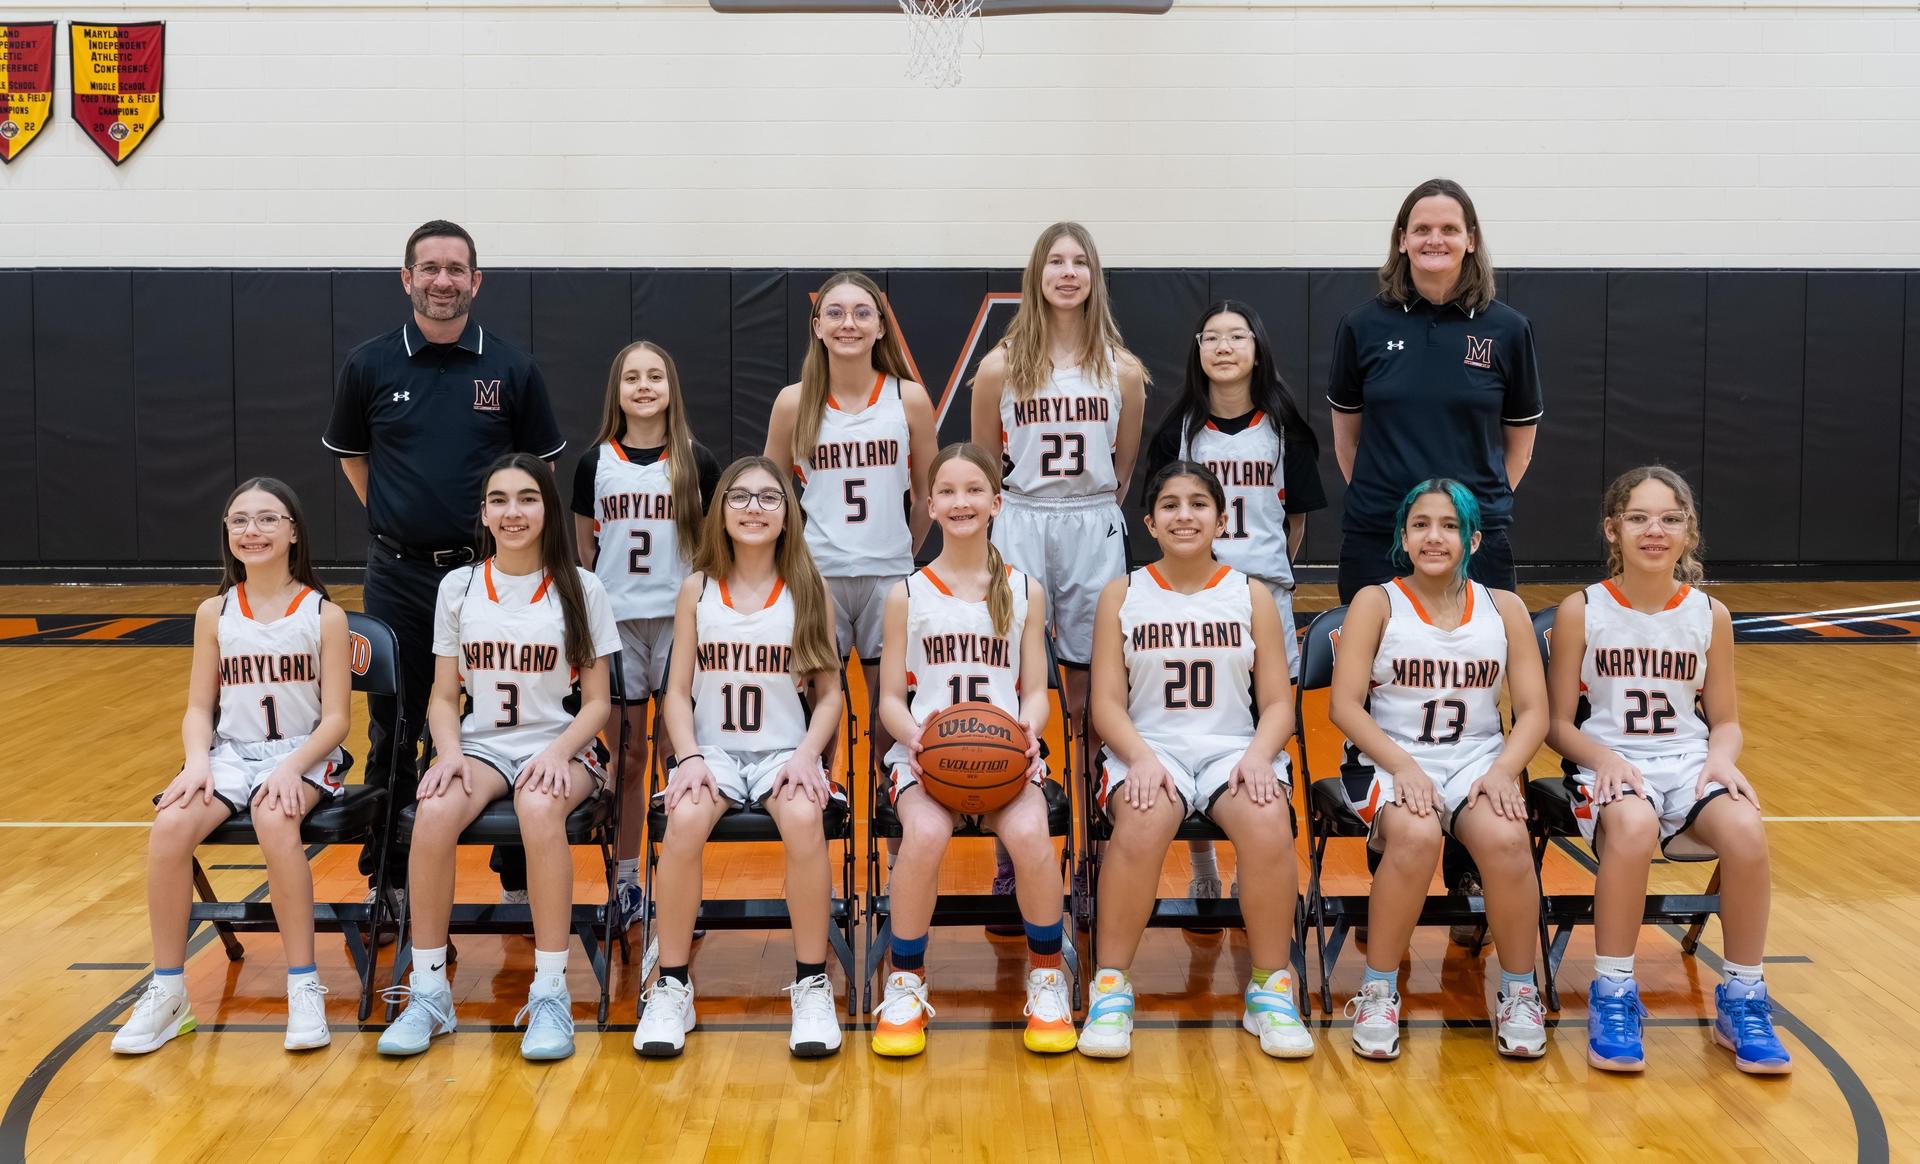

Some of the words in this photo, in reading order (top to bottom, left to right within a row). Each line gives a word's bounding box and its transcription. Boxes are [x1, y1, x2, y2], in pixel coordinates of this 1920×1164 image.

[84, 29, 129, 38] MARYLAND
[89, 40, 147, 50] INDEPENDENT
[0, 64, 39, 72] FERENCE
[91, 52, 133, 62] ATHLETIC
[94, 63, 149, 74] CONFERENCE
[9, 82, 36, 90] SCHOOL
[27, 93, 46, 102] FIELD
[90, 81, 116, 91] MIDDLE
[118, 83, 146, 91] SCHOOL
[102, 94, 125, 103] TRACK
[128, 95, 135, 103] &
[137, 94, 156, 103] FIELD
[98, 107, 139, 116] CHAMPIONS
[24, 122, 35, 132] 22
[93, 123, 105, 133] 20
[133, 123, 144, 133] 24
[1465, 335, 1493, 364] M
[473, 379, 500, 406] M
[1013, 397, 1110, 427] MARYLAND
[1040, 432, 1086, 478] 23
[600, 492, 674, 523] MARYLAN
[843, 478, 867, 524] 5
[1215, 496, 1249, 539] 1
[628, 529, 652, 575] 2
[1132, 621, 1242, 651] MARYLAND
[1392, 658, 1500, 689] MARYLAND
[1595, 648, 1698, 681] MARYLAND
[947, 674, 992, 704] 15
[1164, 659, 1215, 710] 20
[260, 694, 284, 741] 1
[495, 681, 520, 728] 3
[721, 682, 764, 733] 10
[1624, 688, 1677, 736] 22
[937, 717, 1012, 742] Wilson
[1416, 699, 1468, 744] 13
[939, 758, 1008, 771] EVOLUTION
